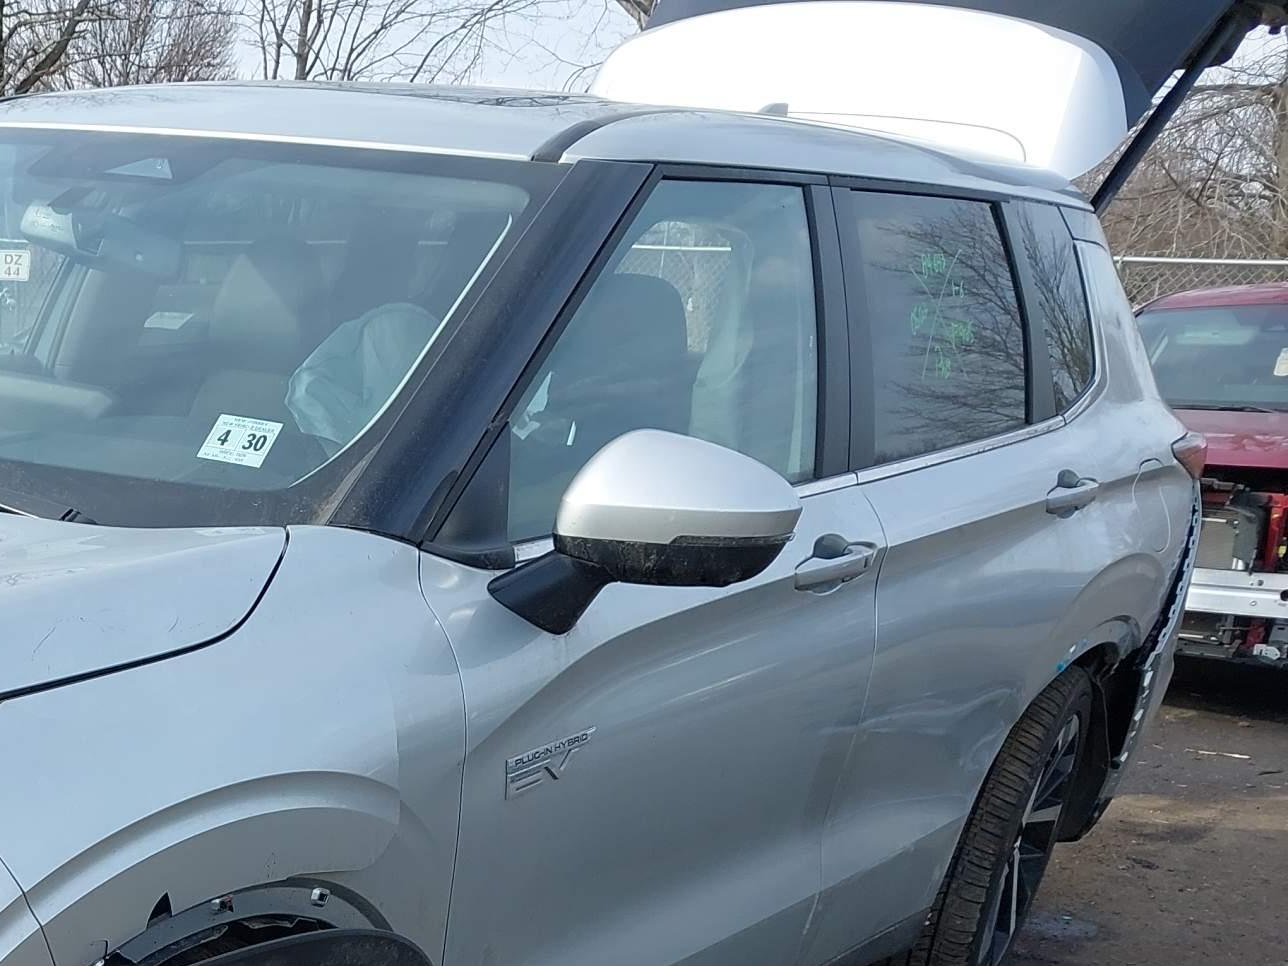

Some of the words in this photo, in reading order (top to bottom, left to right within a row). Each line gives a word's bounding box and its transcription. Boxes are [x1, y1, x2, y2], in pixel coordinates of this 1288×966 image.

[4, 254, 23, 265] DZ
[4, 266, 20, 276] 44
[217, 429, 232, 446] 4
[241, 432, 268, 452] 30
[514, 745, 553, 768] PLUG-IN
[554, 732, 589, 752] HYBRID
